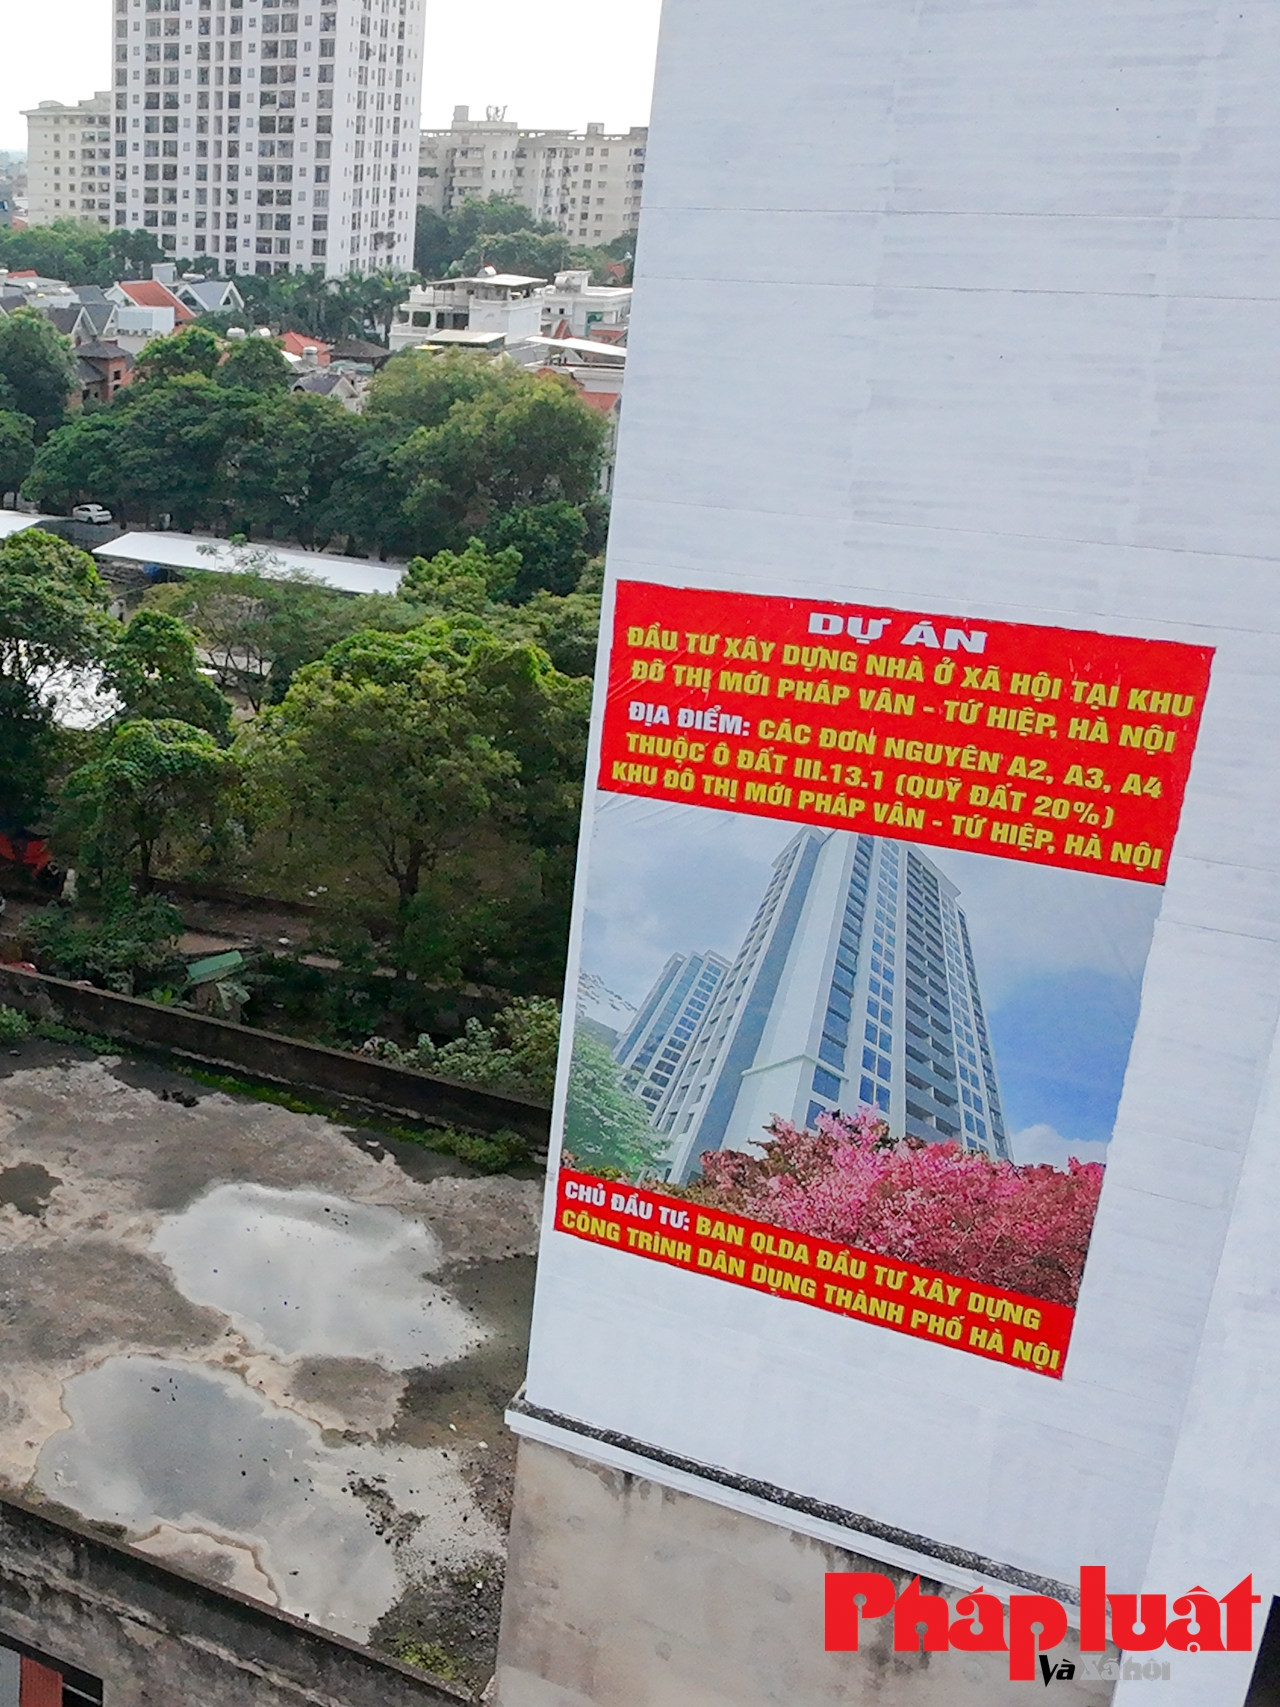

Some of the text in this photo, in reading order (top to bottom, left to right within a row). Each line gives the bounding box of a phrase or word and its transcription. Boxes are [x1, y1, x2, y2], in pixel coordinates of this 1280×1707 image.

[627, 622, 1193, 717] ĐẦU TƯ XÂY DỰNG NHÀ Ở XÃ HỘI TẠI KHU
[808, 612, 988, 653] DỰ ÁN
[629, 701, 1162, 799] ĐỊA ĐIỂM: CÁC ĐƠN NGUYÊN A2, A3, A4
[632, 659, 665, 682] ĐÔ
[672, 664, 711, 693] THỊ
[718, 670, 770, 696] MỚI
[777, 677, 850, 705] PHÁP
[859, 687, 915, 716] VÂN
[944, 699, 983, 724] TỨ
[986, 706, 1057, 738] HIỆP,
[1068, 716, 1108, 743] HÀ
[1119, 724, 1176, 755] NỘI
[612, 761, 657, 785] KHU
[663, 768, 695, 791] ĐÔ
[702, 774, 738, 802] THỊ
[744, 781, 792, 807] MỚI
[798, 790, 866, 818] PHÁP
[873, 801, 925, 829] VÂN
[952, 813, 987, 838] TỨ
[990, 822, 1055, 853] HIỆP,
[1064, 832, 1102, 860] HÀ
[1110, 841, 1163, 871] NỘI
[626, 732, 1115, 829] THUỘC Ô ĐẤT III.13.1 (QUỸ ĐẤT 20%)
[561, 1209, 1060, 1371] CÔNG TRÌNH DÂN DỤNG THÀNH PHỐ HÀ NỘI
[565, 1181, 1042, 1330] CHỦ ĐẦU TƯ: BAN QLDA ĐẦU TƯ XÂY DỰNG
